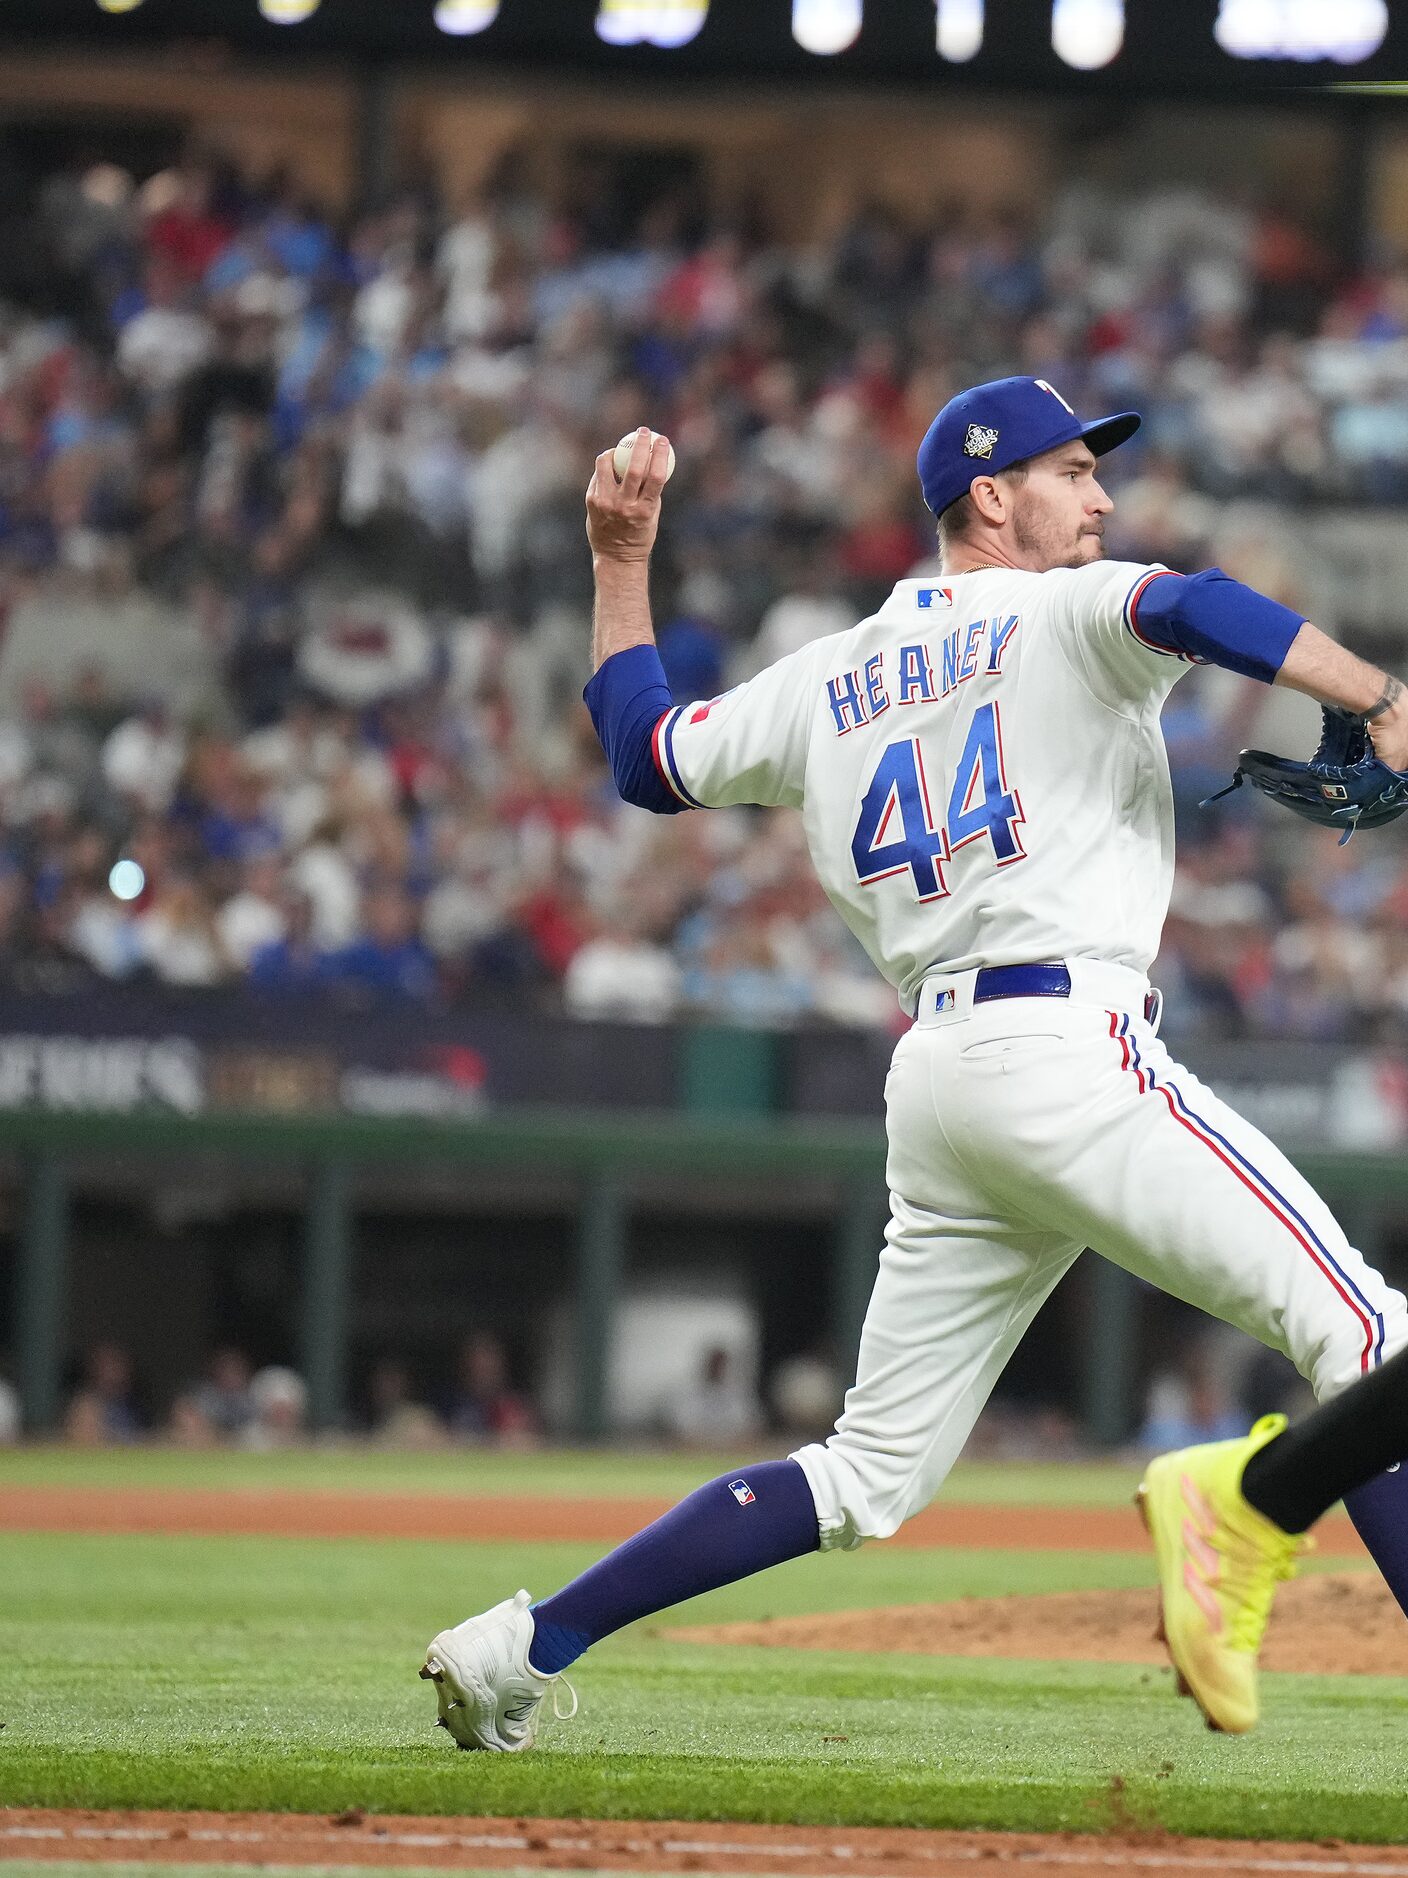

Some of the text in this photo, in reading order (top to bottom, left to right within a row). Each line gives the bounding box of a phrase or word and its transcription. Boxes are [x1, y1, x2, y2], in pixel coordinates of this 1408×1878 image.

[965, 429, 994, 449] WORLD
[968, 435, 998, 457] SERIES
[826, 614, 1020, 737] HEANEY
[850, 700, 1028, 904] 44
